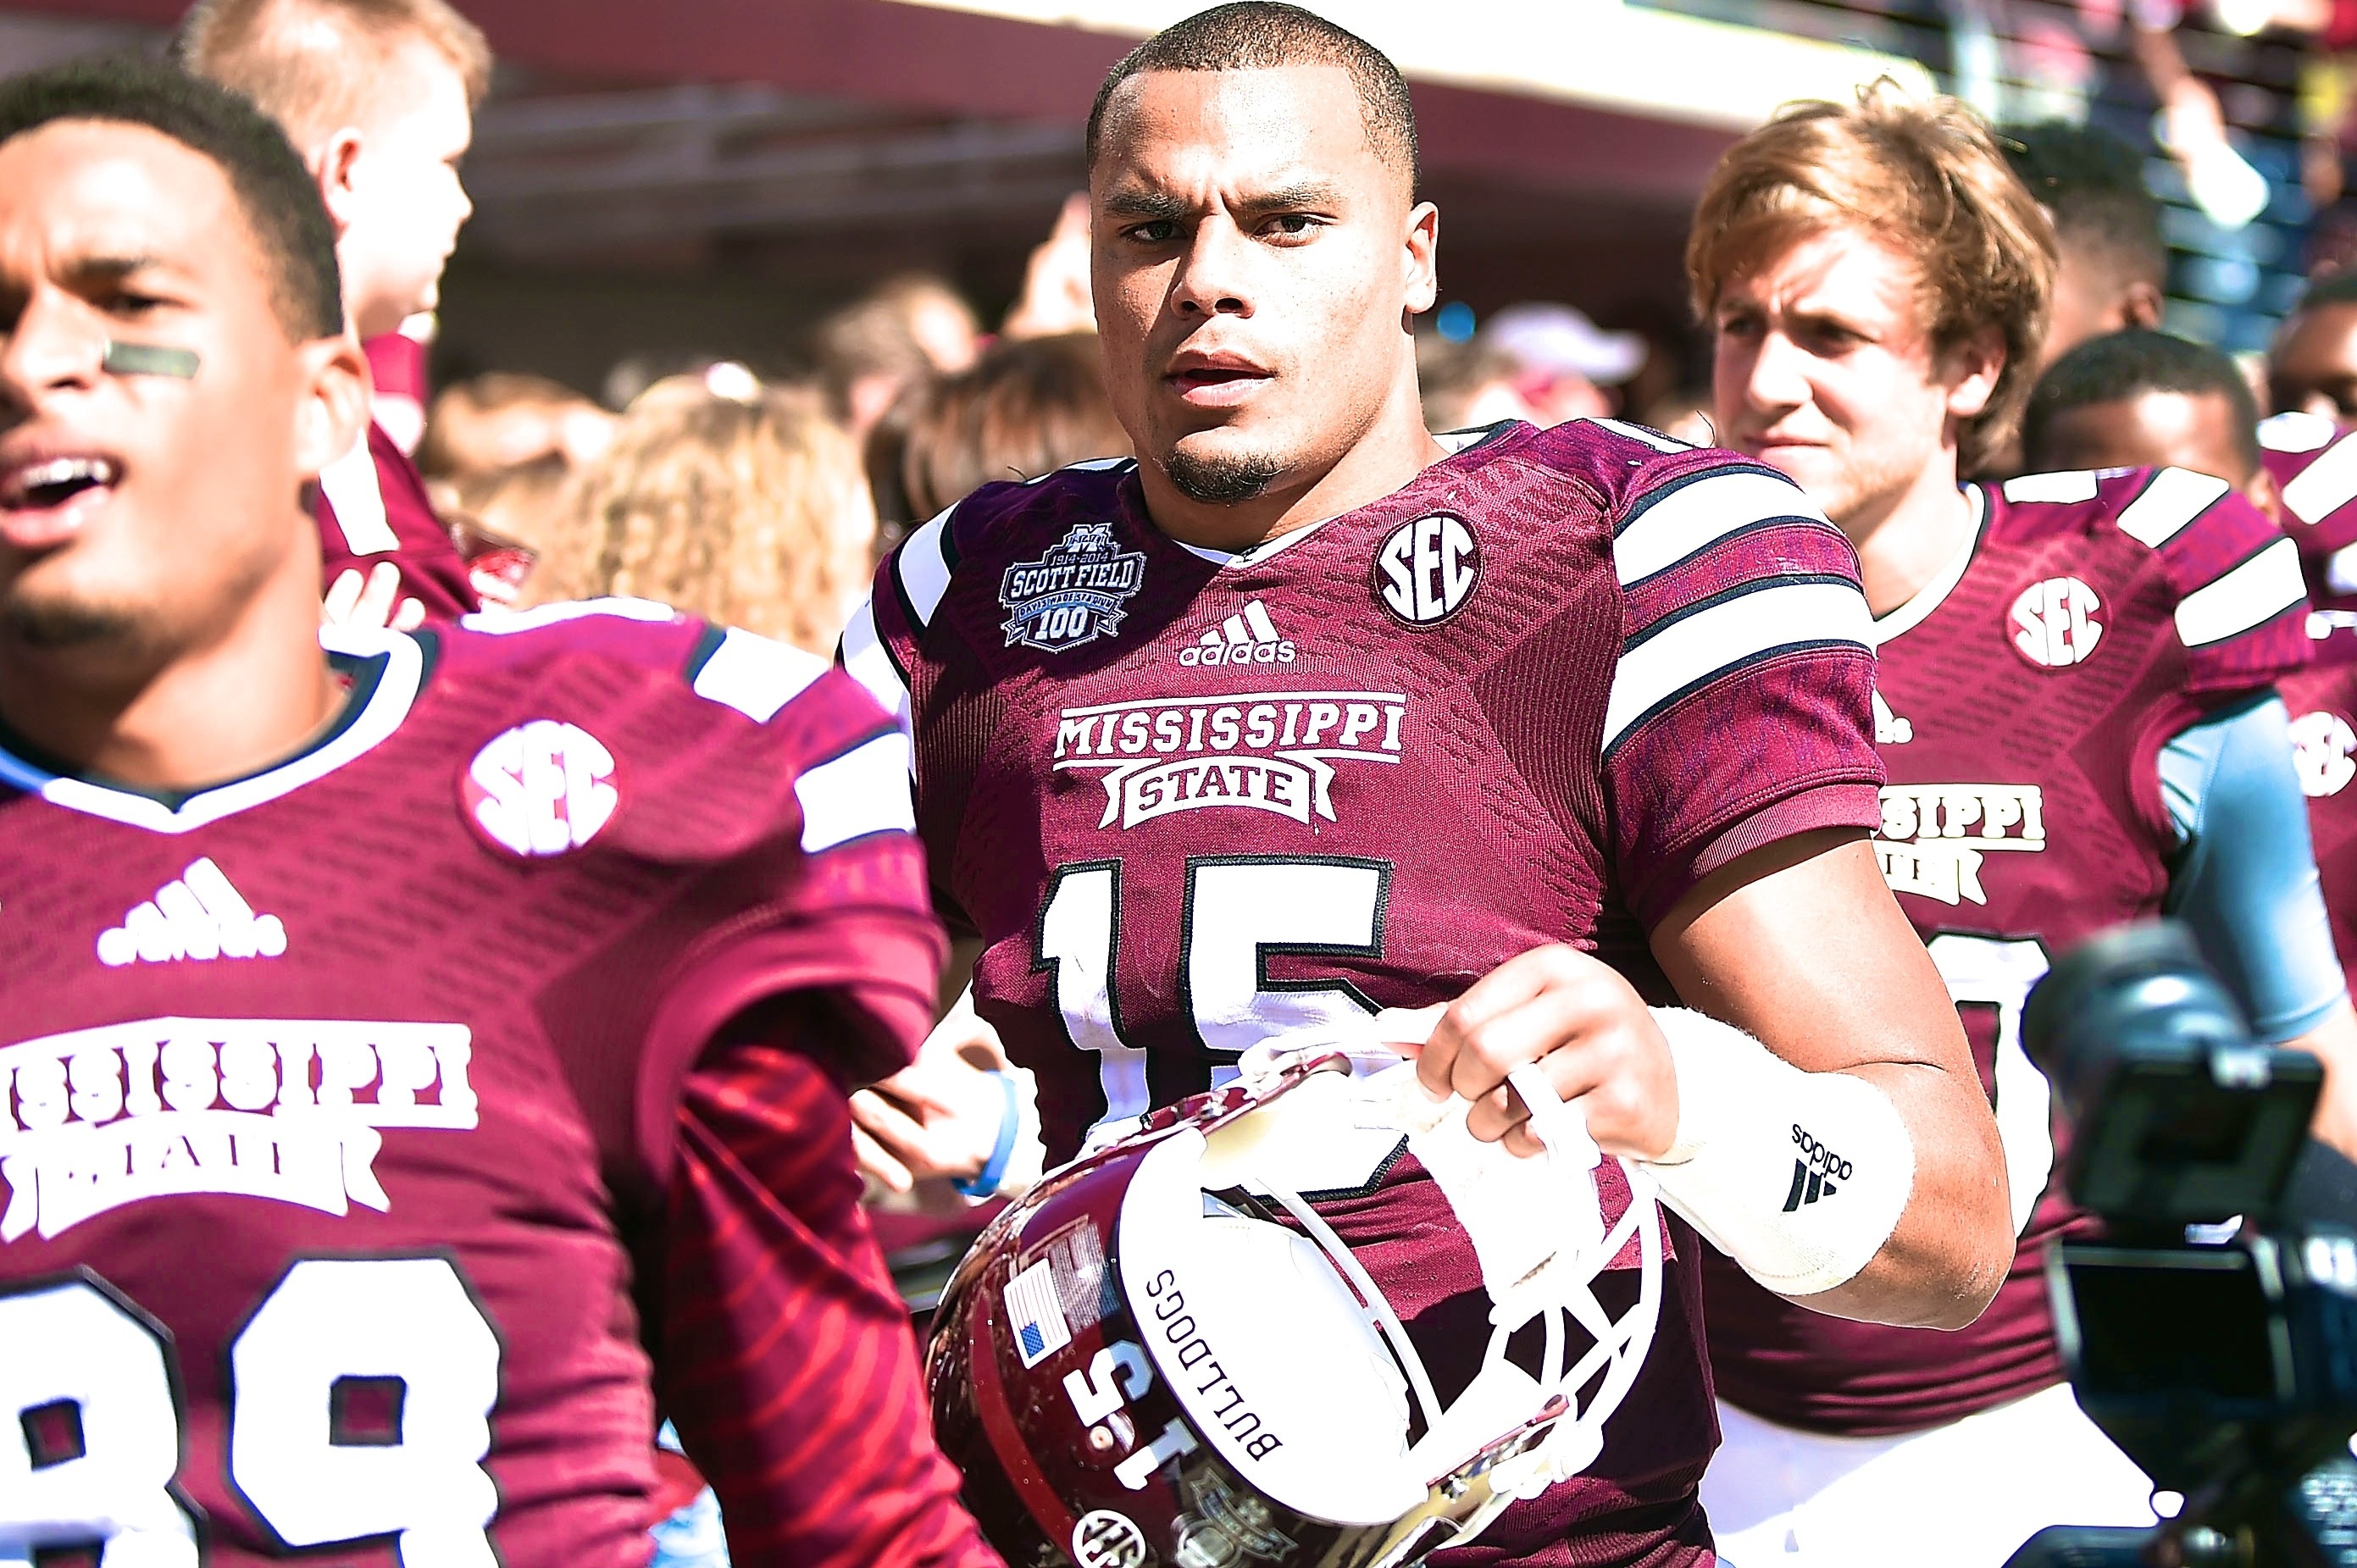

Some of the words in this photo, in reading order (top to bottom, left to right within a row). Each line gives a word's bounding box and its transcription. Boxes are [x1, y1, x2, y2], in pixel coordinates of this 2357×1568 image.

[1010, 565, 1076, 598] SCOTT
[1074, 559, 1135, 589] FIELD
[1378, 516, 1476, 622] SEC
[1019, 599, 1047, 617] DAVIS
[1034, 606, 1089, 640] 100
[2010, 576, 2104, 667] SEC
[1178, 636, 1295, 668] adidas
[1053, 703, 1406, 760] MISSISSIPPI
[469, 720, 619, 856] SEC
[1138, 764, 1293, 812] STATE
[1031, 853, 1408, 1209] 15
[1791, 1123, 1853, 1181] adidas
[1145, 1270, 1284, 1462] BULLDOGS
[1062, 1338, 1200, 1491] 15
